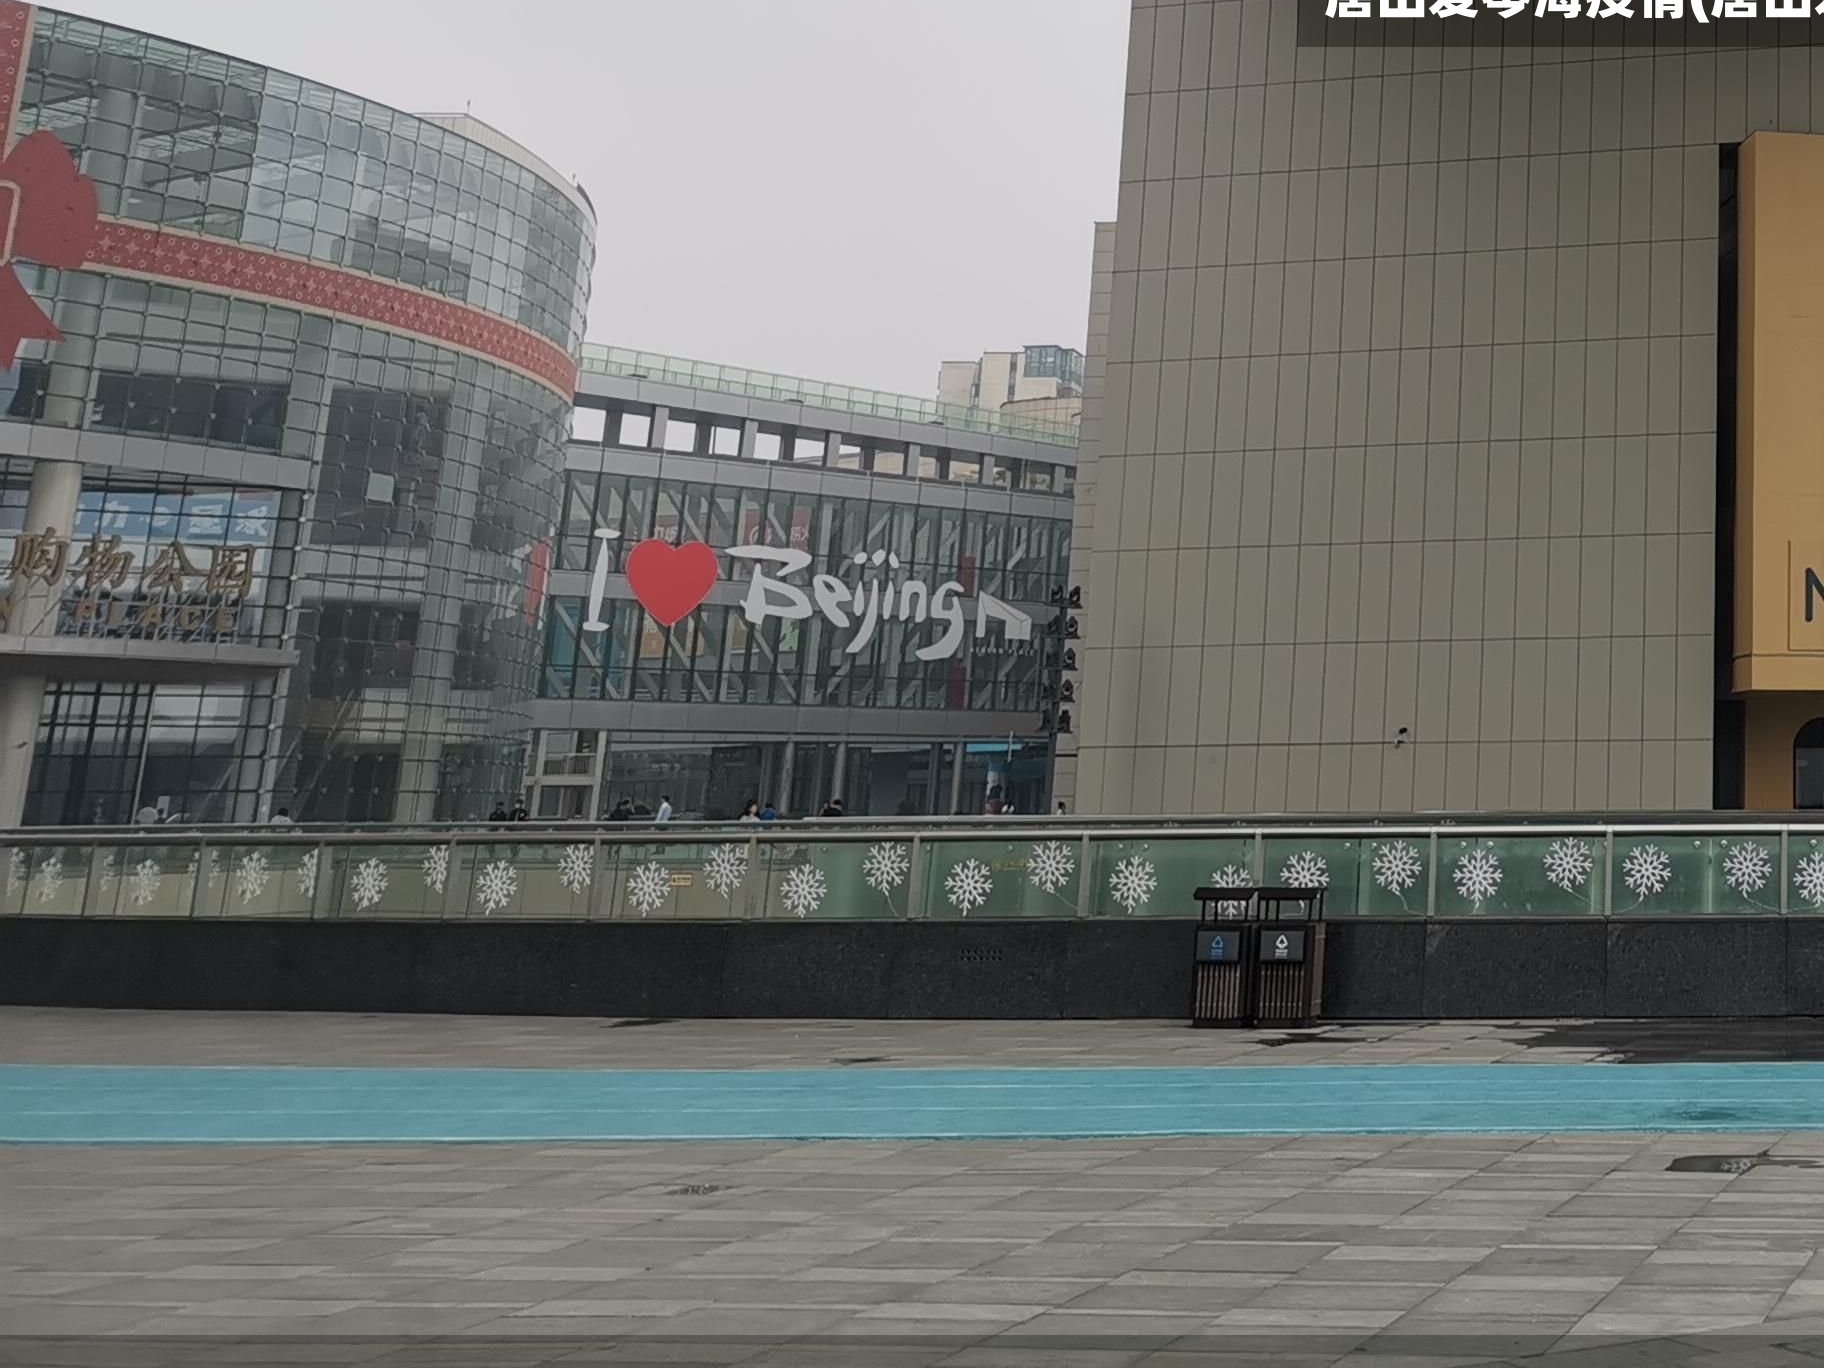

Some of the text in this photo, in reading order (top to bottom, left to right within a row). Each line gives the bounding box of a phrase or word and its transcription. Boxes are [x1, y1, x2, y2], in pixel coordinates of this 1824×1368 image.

[6, 527, 256, 599] 购物公园
[583, 528, 964, 661] I Beijing
